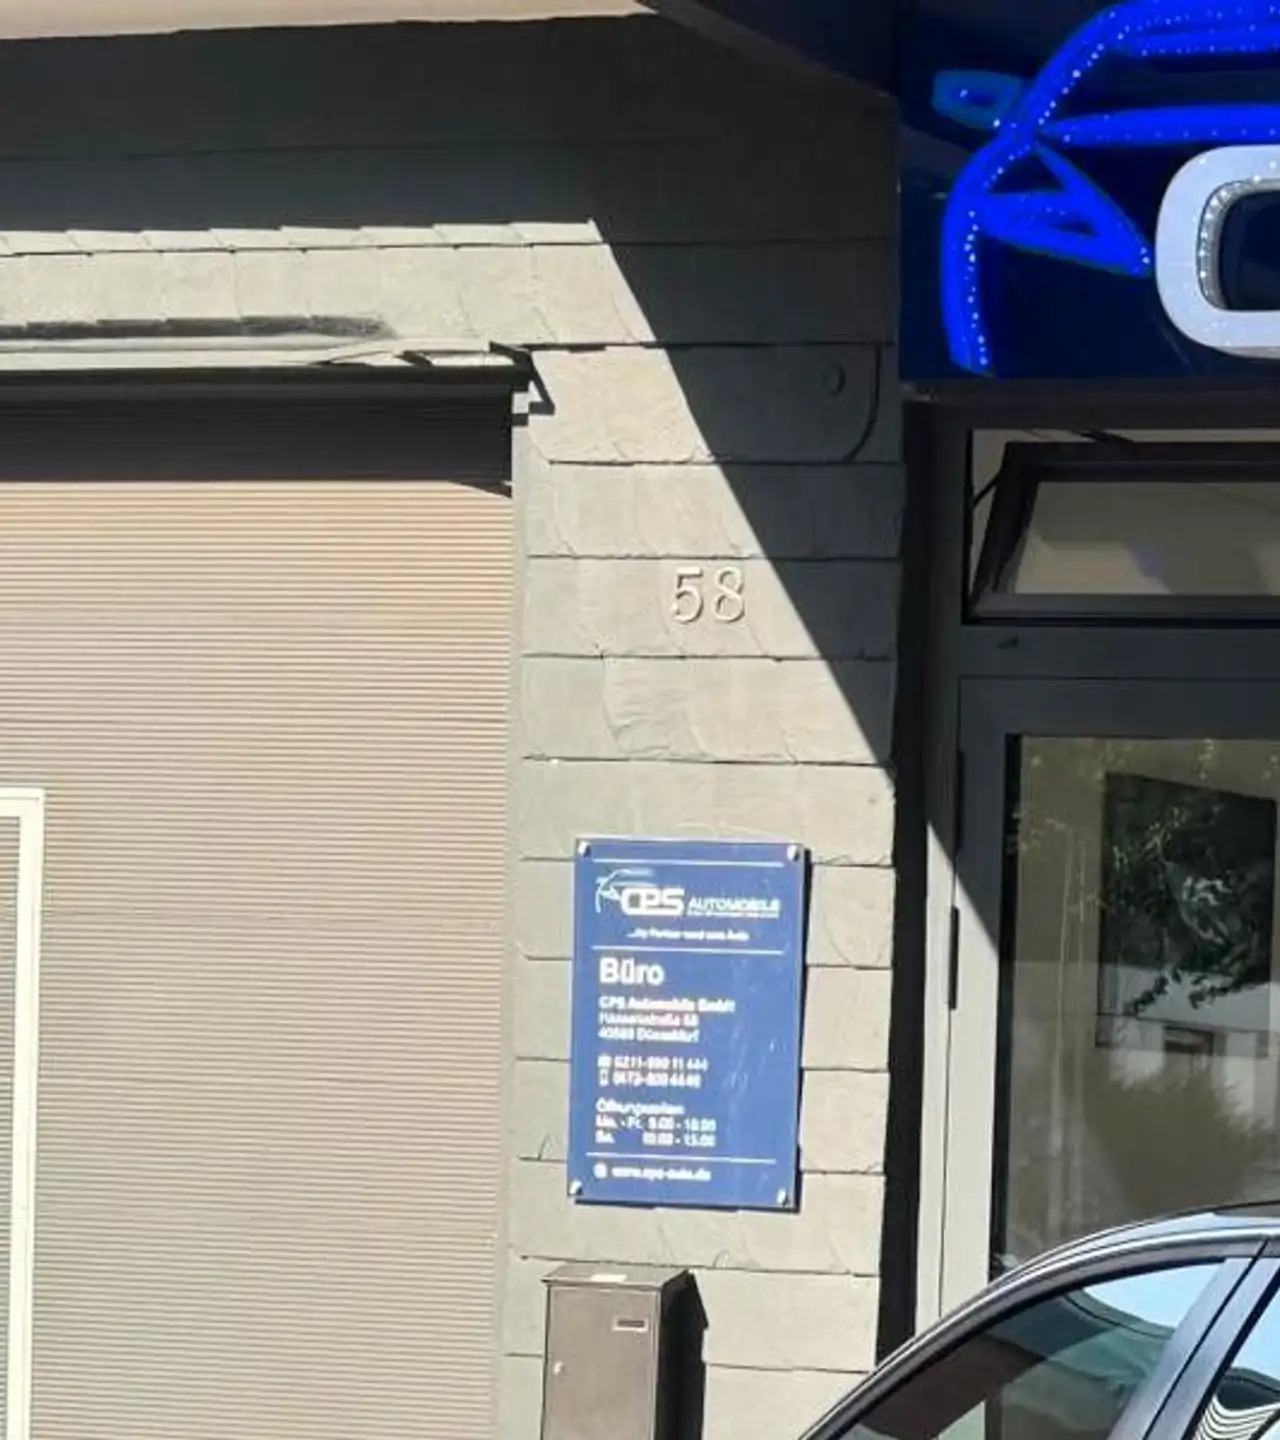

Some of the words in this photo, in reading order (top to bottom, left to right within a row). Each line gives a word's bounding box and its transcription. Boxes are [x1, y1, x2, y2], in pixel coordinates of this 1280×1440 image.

[672, 566, 745, 624] 58
[620, 887, 685, 917] CPS
[599, 956, 665, 986] Büro
